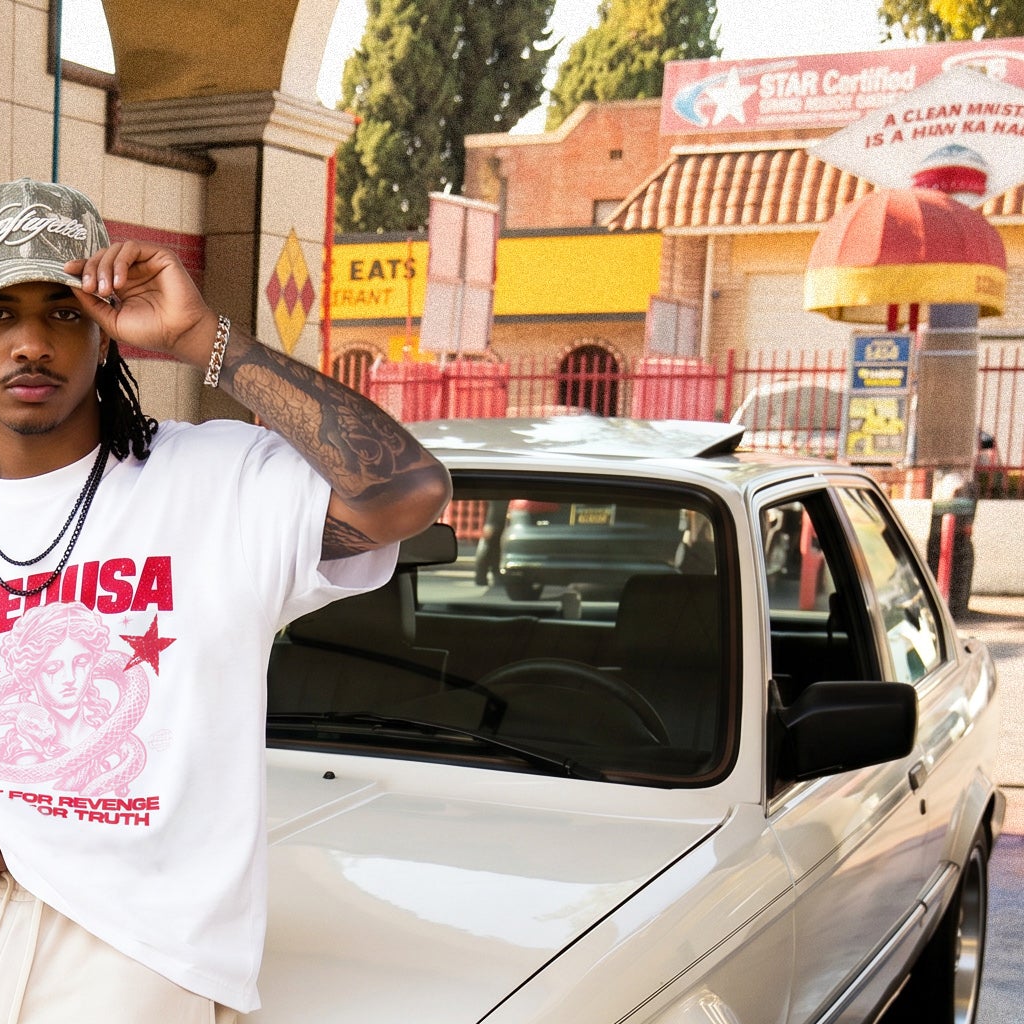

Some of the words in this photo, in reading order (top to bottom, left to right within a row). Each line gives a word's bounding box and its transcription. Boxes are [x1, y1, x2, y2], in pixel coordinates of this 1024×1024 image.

[759, 70, 819, 98] STAR
[823, 66, 917, 94] Certified
[884, 113, 897, 128] A
[903, 103, 963, 124] CLEAN
[865, 132, 885, 149] IS
[891, 129, 904, 144] A
[350, 258, 416, 281] EATS
[8, 790, 54, 806] FOR
[59, 795, 160, 811] REVENGE
[74, 809, 150, 827] TRUTH
